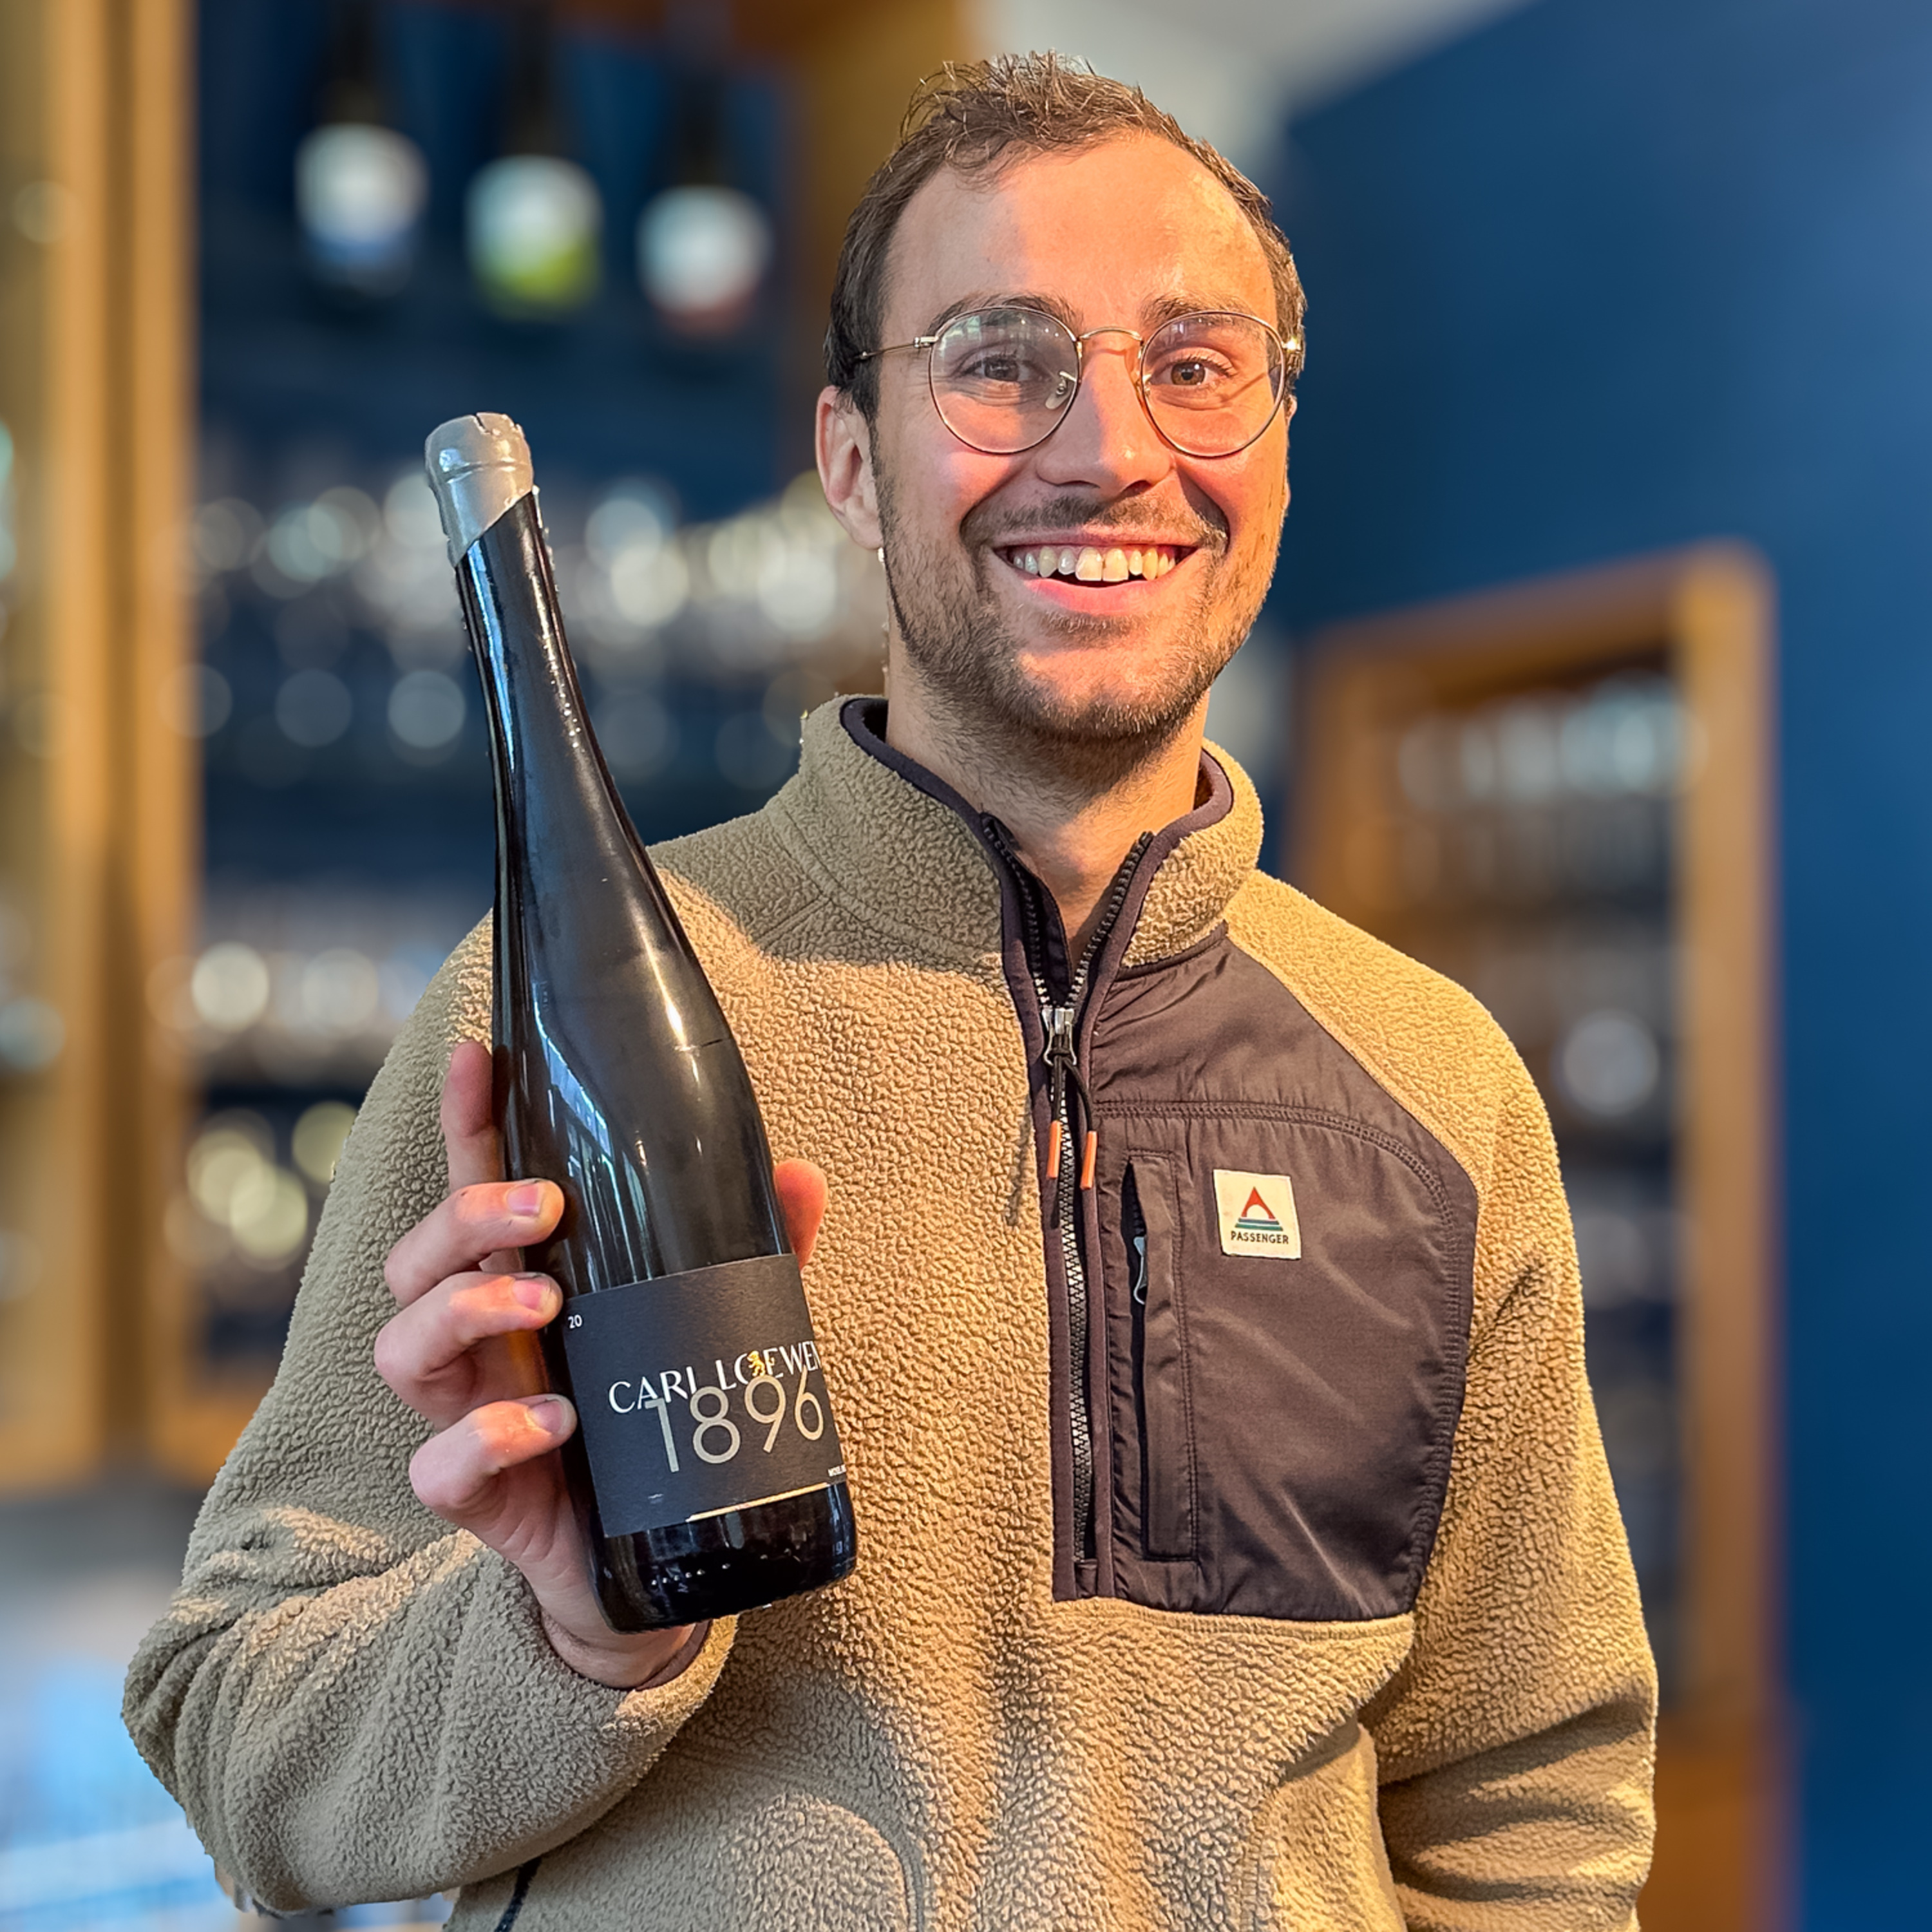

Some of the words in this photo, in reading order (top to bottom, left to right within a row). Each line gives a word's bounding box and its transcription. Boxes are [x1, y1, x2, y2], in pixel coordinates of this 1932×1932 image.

[1231, 1231, 1289, 1245] PASSENGER
[567, 1314, 583, 1329] 20
[645, 1364, 824, 1473] 1896
